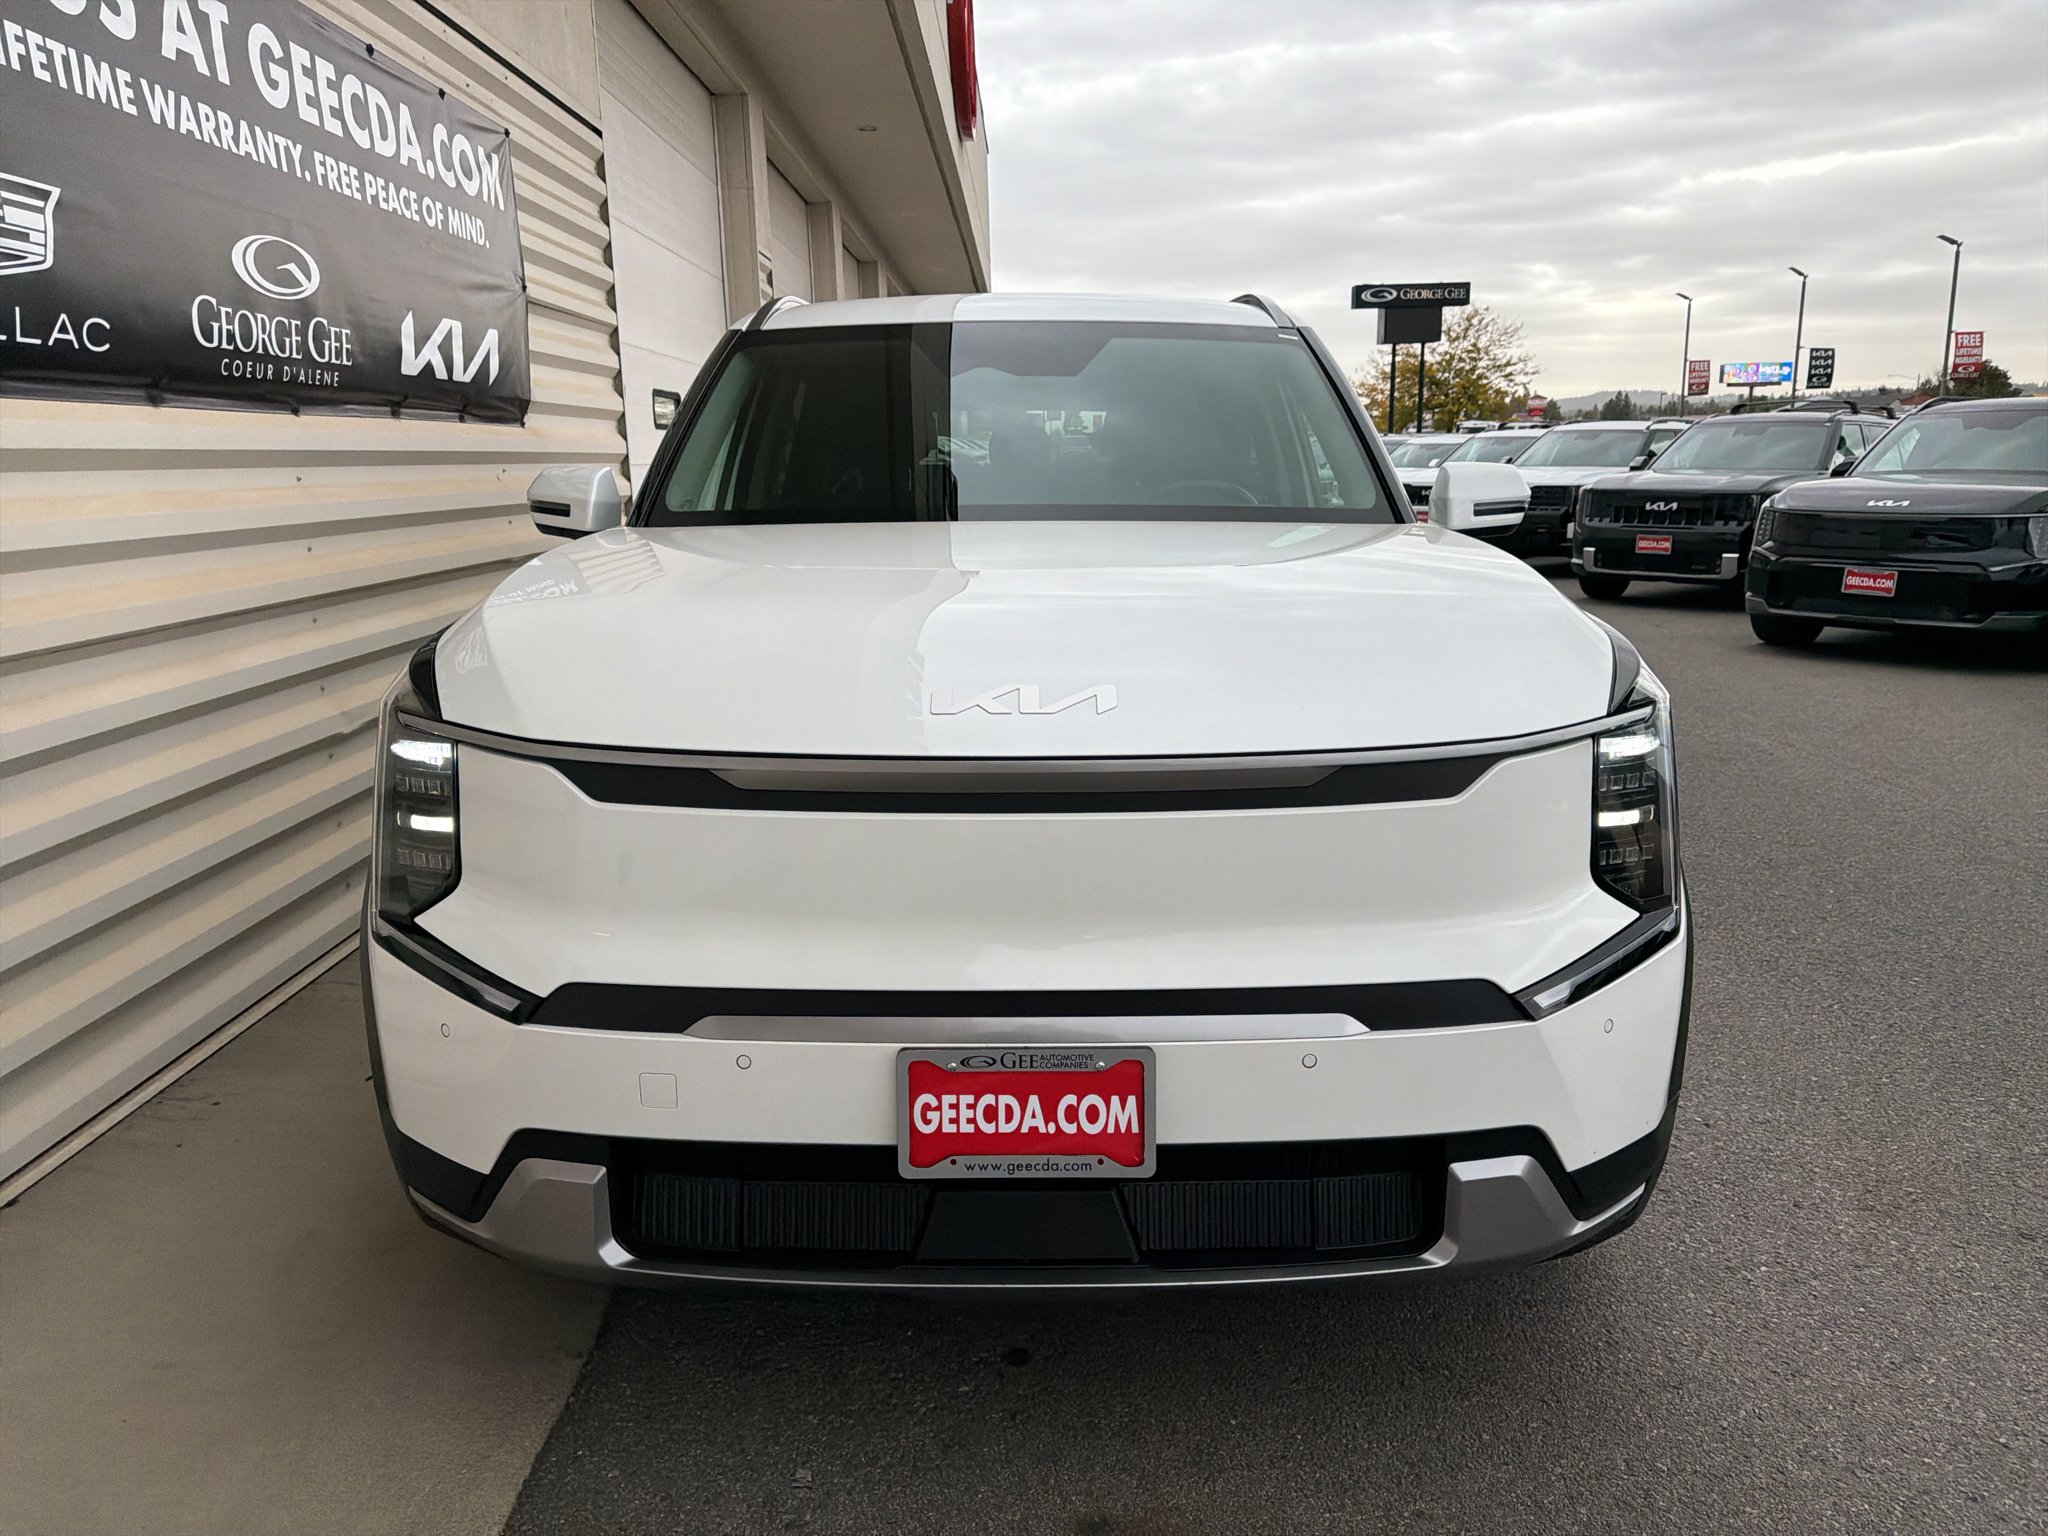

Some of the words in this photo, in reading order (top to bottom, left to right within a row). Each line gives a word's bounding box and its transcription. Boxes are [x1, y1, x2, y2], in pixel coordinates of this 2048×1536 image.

[162, 0, 230, 85] AT
[248, 23, 505, 211] GEECDA.COM
[0, 19, 138, 116] FETIME
[139, 77, 311, 183] WARRANTY.
[313, 151, 362, 201] FREE
[364, 171, 420, 222] PEACE
[422, 196, 444, 230] OF
[447, 206, 490, 249] MIND.
[1400, 287, 1444, 300] GEORGE
[1444, 287, 1467, 299] GEE
[0, 306, 111, 352] LAC
[191, 294, 303, 360] GEORGE
[307, 316, 353, 366] GEE
[1957, 334, 1982, 347] FREE
[401, 310, 499, 386] KIA
[221, 358, 274, 380] COEUR
[282, 365, 340, 387] D'ALENE
[1691, 361, 1709, 371] FREE
[1645, 501, 1679, 511] KIA
[1846, 576, 1894, 588] GEECDA.COM
[929, 684, 1118, 716] KIA
[1000, 1052, 1040, 1069] GEE
[1040, 1053, 1094, 1062] AUTOMOTIVE
[1040, 1061, 1089, 1069] COMPANIES
[913, 1093, 1139, 1134] GEECDA.COM
[964, 1158, 1092, 1175] www.geecda.com
